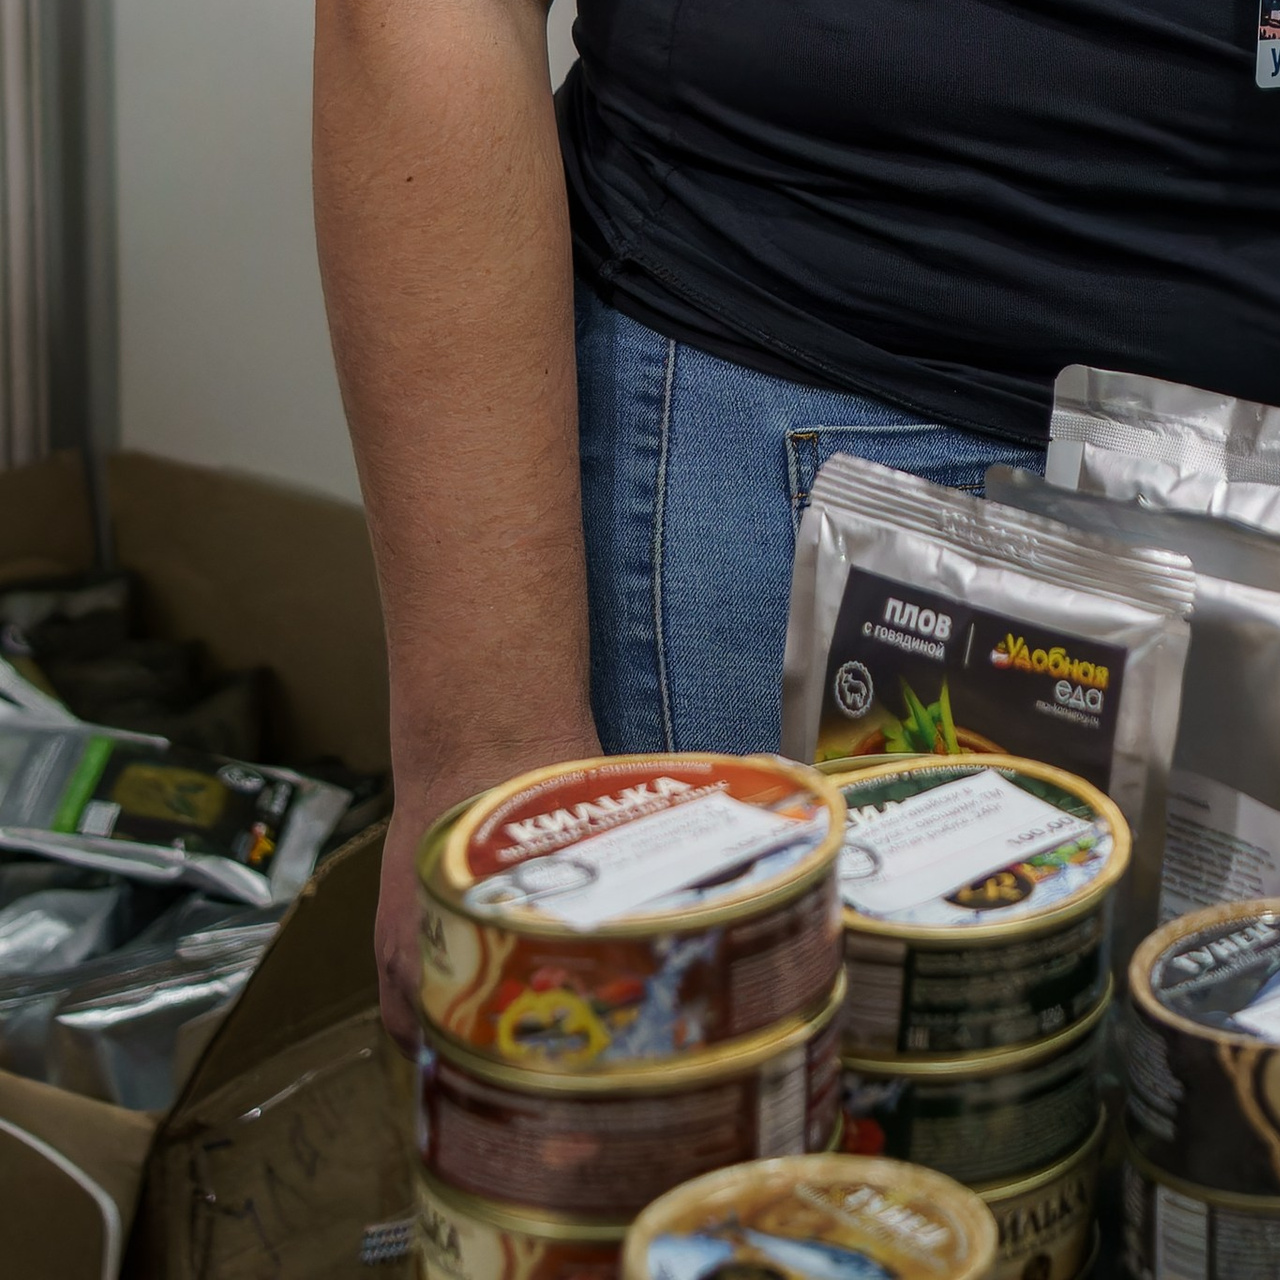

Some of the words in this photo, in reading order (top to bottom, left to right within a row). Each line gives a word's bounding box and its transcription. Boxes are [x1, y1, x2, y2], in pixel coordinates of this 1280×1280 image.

[863, 621, 873, 636] с
[874, 623, 945, 662] говядиной
[884, 596, 952, 640] ПЛОВ
[1006, 633, 1110, 689] Удобная
[1054, 679, 1104, 714] еда
